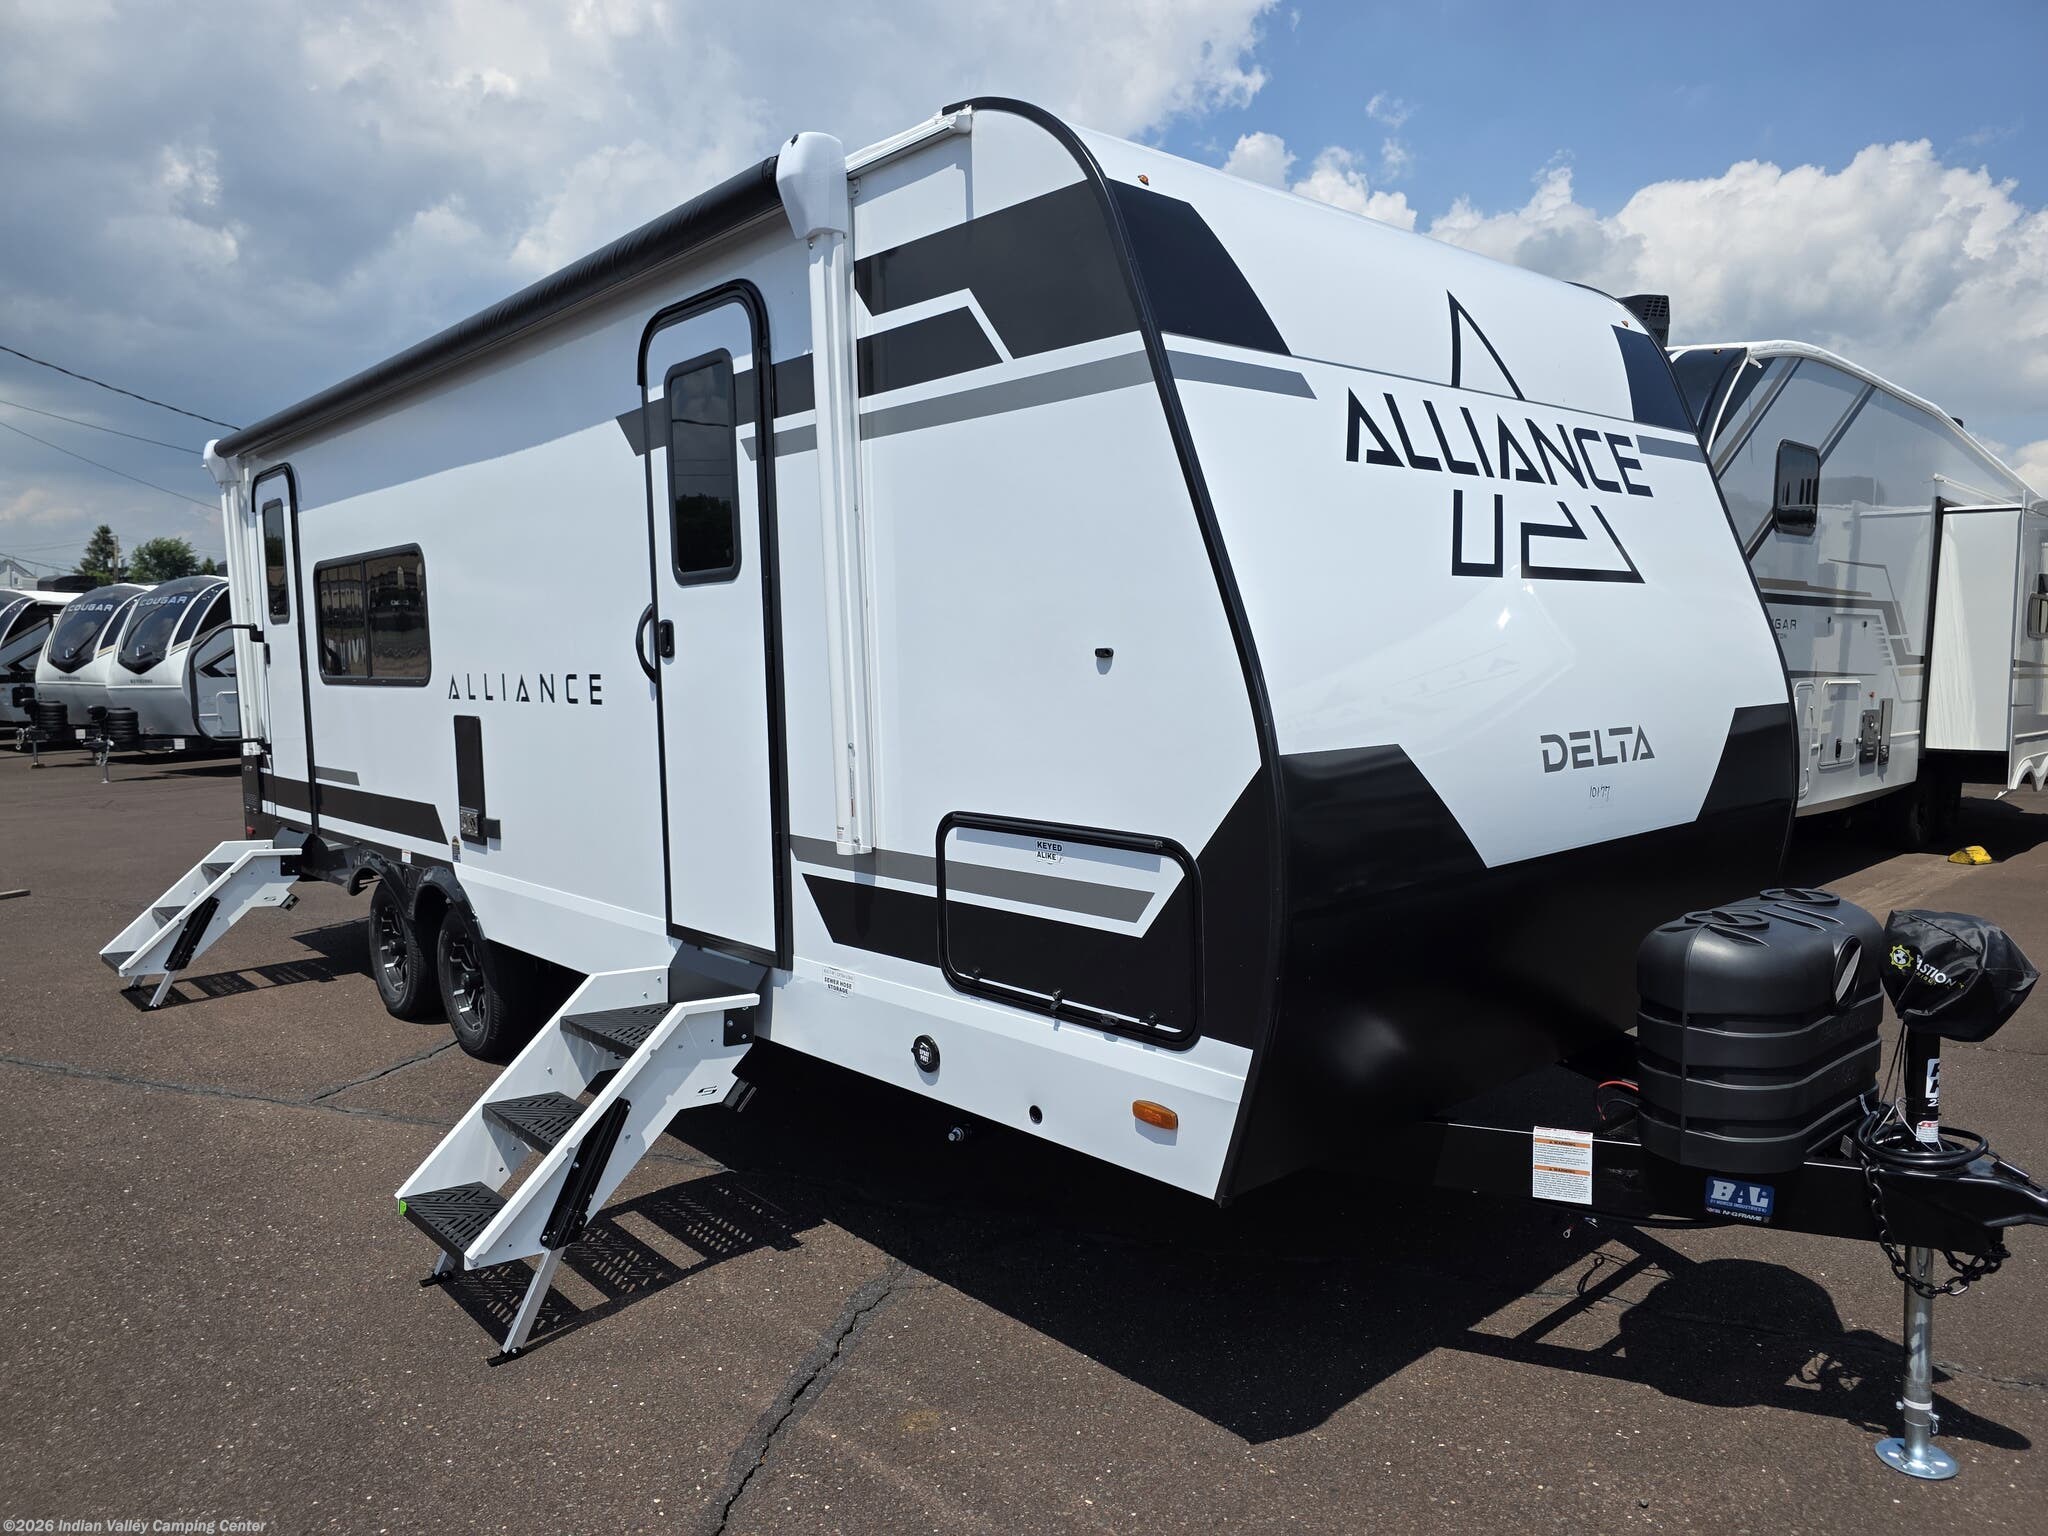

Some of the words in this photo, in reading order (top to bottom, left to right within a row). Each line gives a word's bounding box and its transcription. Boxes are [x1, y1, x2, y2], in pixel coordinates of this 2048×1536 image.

[1346, 386, 1654, 498] ALLIANCE
[139, 595, 188, 607] COUGAR
[67, 603, 114, 612] COUGAR
[1773, 618, 1797, 630] GAR
[448, 673, 603, 705] ALLIANCE
[1540, 724, 1656, 773] DELTA
[1036, 840, 1063, 852] KEYED
[1036, 851, 1057, 861] ALIKE
[824, 976, 839, 985] SEWER
[840, 981, 852, 990] HOSE
[827, 983, 849, 995] STORAGE
[1710, 1179, 1769, 1208] BAL
